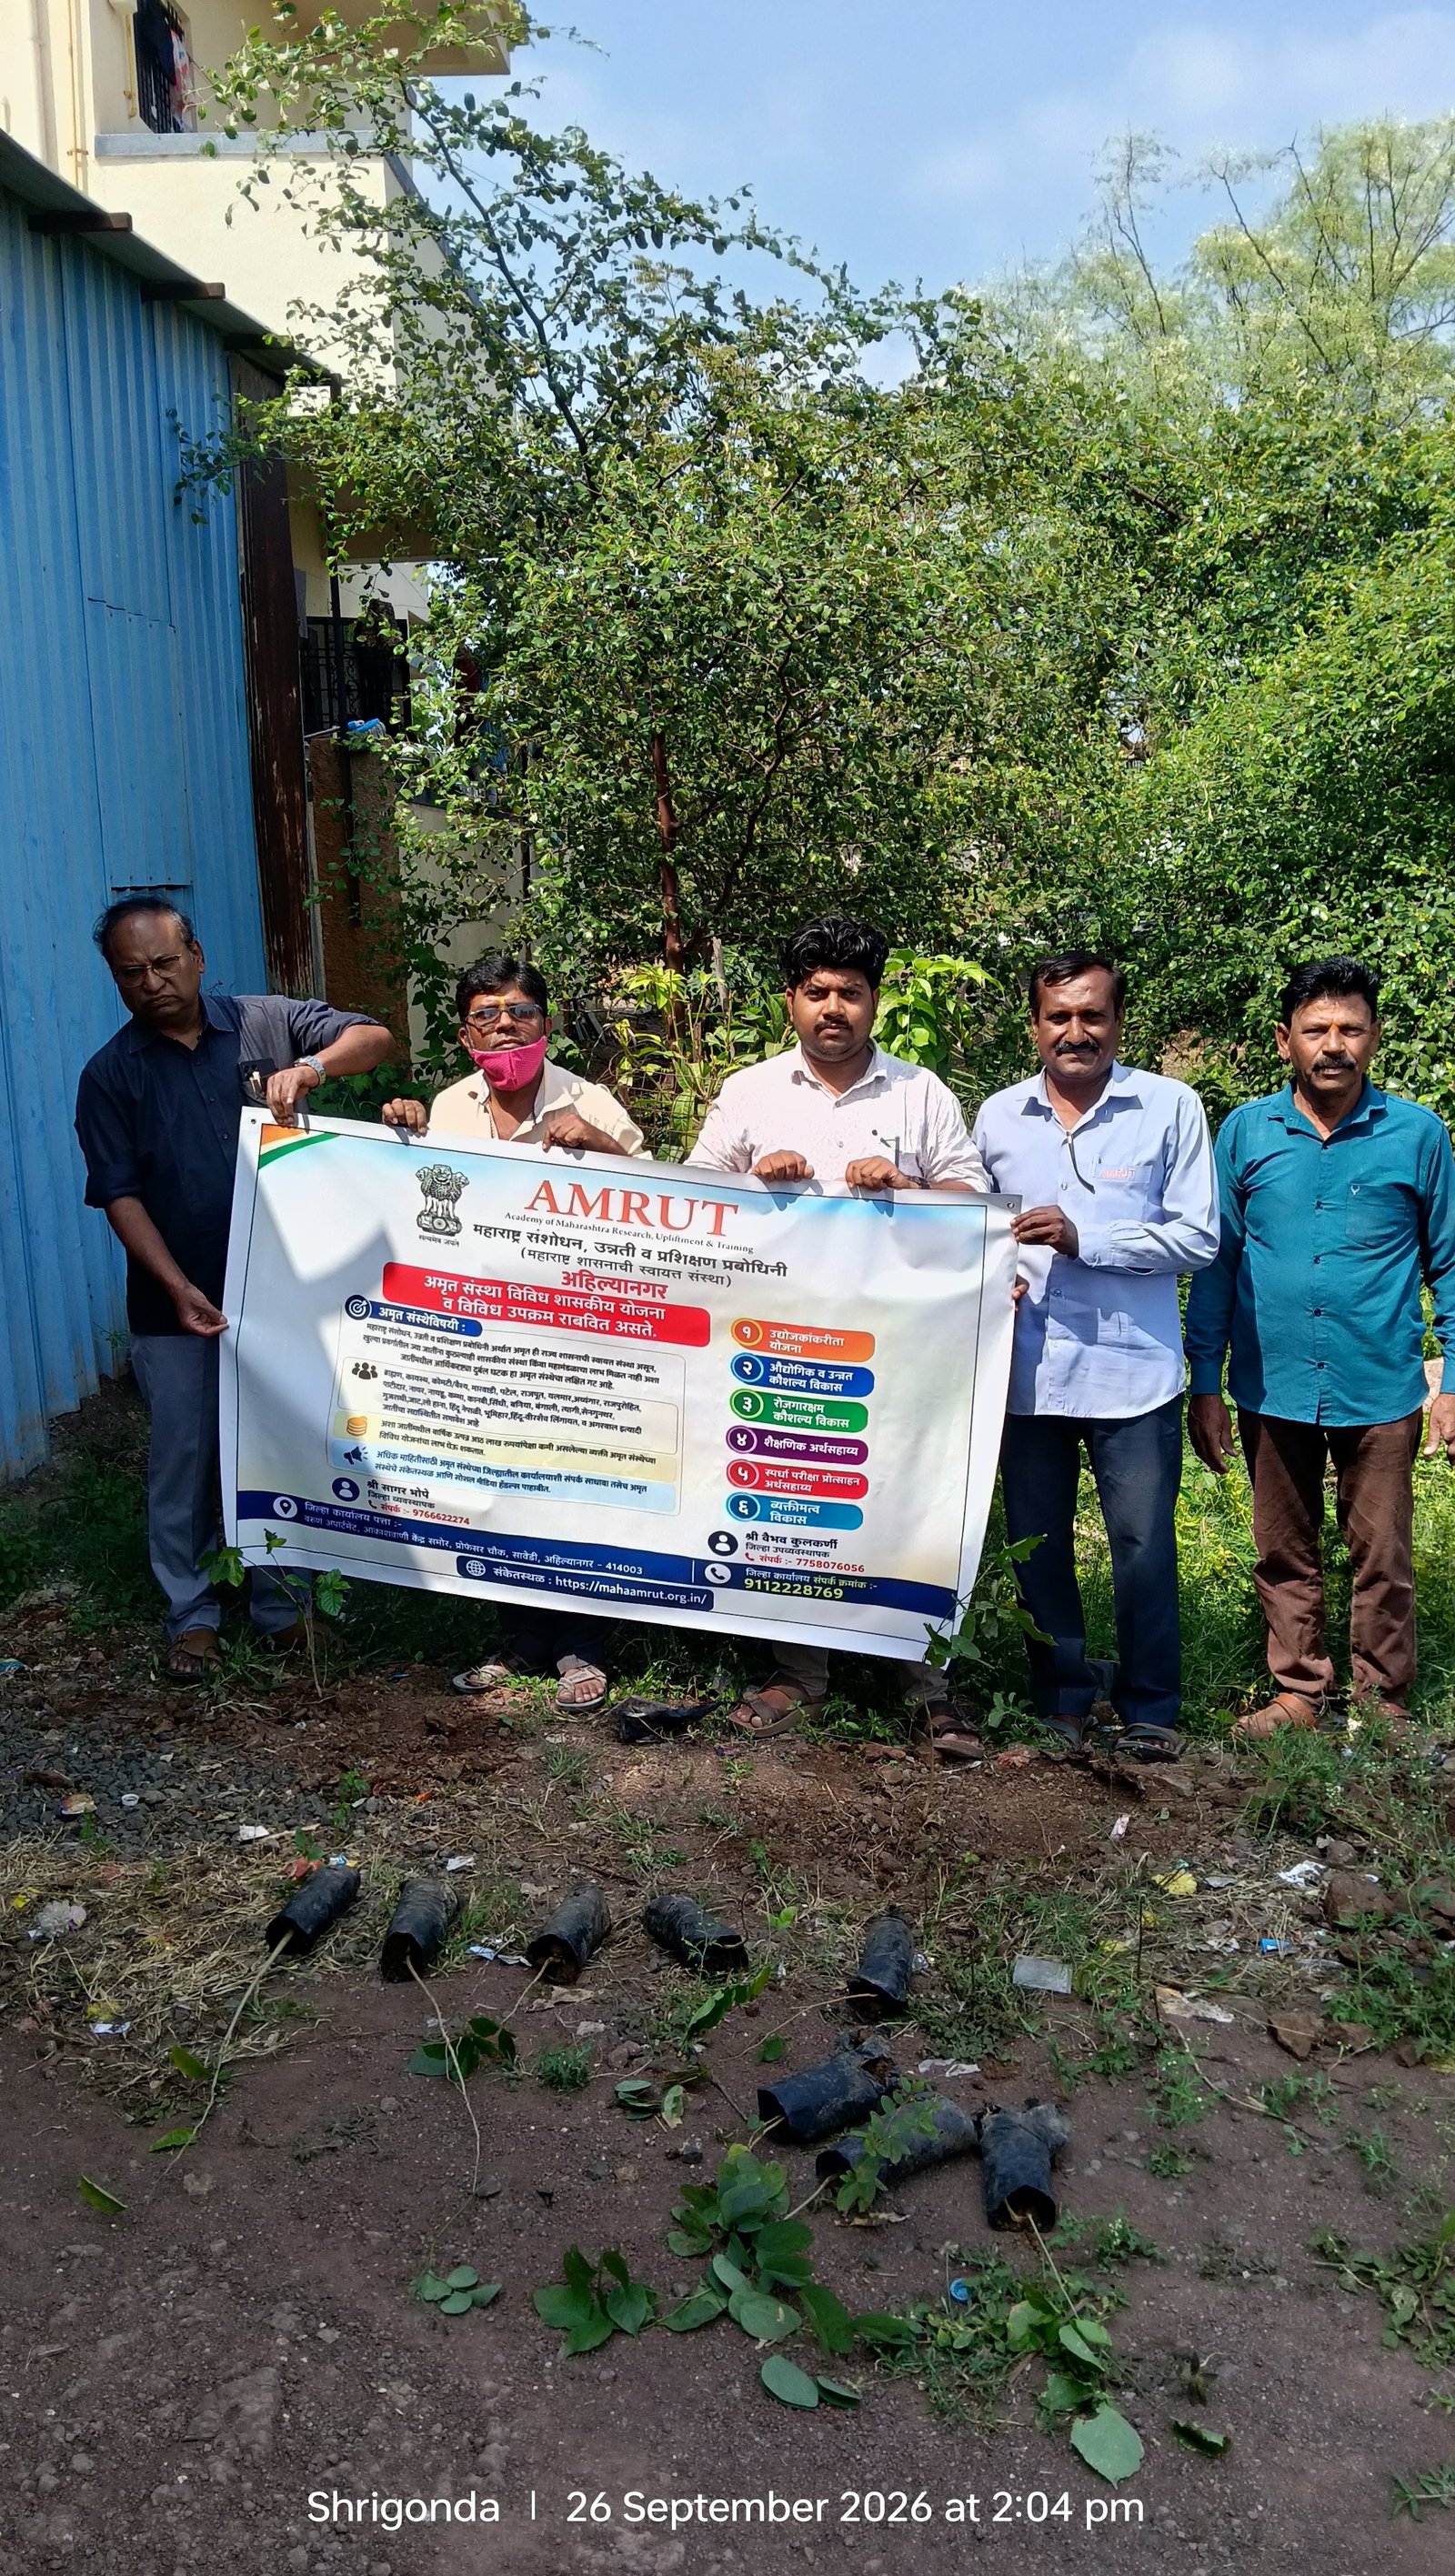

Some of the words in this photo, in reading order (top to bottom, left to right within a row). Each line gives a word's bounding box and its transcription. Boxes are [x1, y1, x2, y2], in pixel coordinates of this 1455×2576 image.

[523, 1179, 739, 1237] AMRUT
[505, 1211, 542, 1225] Academy
[556, 1218, 609, 1233] Maharashtra
[612, 1227, 653, 1239] Research,
[655, 1232, 703, 1246] Upliftment
[717, 1241, 753, 1254] Training
[473, 1223, 521, 1244] महाराष्ट्र
[526, 1228, 587, 1253] संशोधन,
[594, 1241, 637, 1258] उन्नती
[640, 1248, 652, 1259] व
[657, 1248, 717, 1268] प्रशिक्षण
[721, 1258, 788, 1277] प्रबोधिनी
[577, 1256, 633, 1273] शासनाची
[638, 1265, 682, 1279] स्वायत्त
[687, 1269, 731, 1288] संस्था)
[560, 1268, 668, 1299] अहिल्यानगर
[424, 1275, 458, 1295] अमृत
[461, 1279, 502, 1298] संस्था
[507, 1284, 549, 1308] विविध
[553, 1293, 616, 1313] शासकीय
[619, 1298, 666, 1319] योजना
[378, 1306, 405, 1324] अमृत
[406, 1309, 459, 1331] संस्थेविषयी
[442, 1297, 454, 1309] व
[457, 1296, 503, 1318] विविध
[507, 1302, 555, 1323] उपक्रम
[557, 1310, 610, 1330] राबवित
[615, 1317, 657, 1337] असते.
[742, 1326, 751, 1338] १
[769, 1328, 844, 1346] उद्योजकांकरीता
[436, 1336, 462, 1347] प्रशिक्षण
[462, 1339, 489, 1351] प्रबोधिनी
[491, 1344, 512, 1353] अर्थात
[513, 1347, 530, 1357] अमृत
[531, 1347, 539, 1356] ही
[557, 1352, 590, 1362] शासनाची
[615, 1359, 635, 1368] संस्था
[637, 1362, 657, 1373] असून,
[768, 1338, 802, 1354] योजना
[477, 1353, 507, 1365] शासकीय
[507, 1357, 527, 1366] संस्था
[588, 1368, 605, 1376] लाभ
[627, 1372, 642, 1382] नाही
[644, 1375, 659, 1384] अशा
[742, 1360, 752, 1375] २
[769, 1360, 816, 1379] औद्योगिक
[817, 1368, 826, 1378] व
[519, 1371, 537, 1381] अमृत
[537, 1371, 563, 1382] संस्थेचा
[587, 1378, 597, 1387] गट
[598, 1379, 614, 1390] आहे.
[768, 1372, 808, 1388] कौशल्य
[808, 1378, 843, 1393] विकास
[499, 1387, 519, 1397] पटेल,
[520, 1389, 546, 1400] राजपूत,
[742, 1396, 752, 1412] ३
[773, 1396, 825, 1413] रोजगारक्षम
[467, 1418, 479, 1428] आहे
[772, 1408, 813, 1425] कौशल्य
[815, 1413, 849, 1428] विकास
[736, 1432, 747, 1446] ४
[763, 1434, 807, 1451] शैक्षणिक
[808, 1442, 858, 1456] अर्थसहाय्य
[485, 1438, 502, 1447] लाख
[610, 1450, 627, 1461] अमृत
[376, 1449, 398, 1459] अधिक
[399, 1453, 437, 1465] माहितीसाठी
[438, 1459, 455, 1470] अमृत
[520, 1470, 562, 1481] कार्यालयाशी
[563, 1474, 583, 1483] संपर्क
[610, 1479, 628, 1489] तसेच
[630, 1484, 647, 1494] अमृत
[398, 1465, 434, 1477] संकेतस्थळ
[436, 1470, 453, 1479] आणि
[738, 1466, 748, 1481] ५
[764, 1468, 789, 1479] स्पर्धा
[790, 1469, 819, 1481] परीक्षा
[821, 1472, 860, 1486] प्रोत्साहन
[366, 1478, 378, 1489] श्री
[381, 1483, 406, 1495] सागर
[409, 1487, 429, 1498] भोपे
[764, 1478, 812, 1493] अर्थसहाय्य
[367, 1488, 390, 1501] जिल्हा
[392, 1496, 435, 1509] व्यवस्थापक
[738, 1499, 748, 1515] ६
[769, 1498, 820, 1514] व्यक्तीमत्व
[304, 1500, 329, 1515] जिल्हा
[332, 1509, 370, 1521] कार्यालय
[372, 1516, 391, 1526] पत्ता
[380, 1502, 401, 1513] संपर्क
[412, 1509, 470, 1525] 9766622274
[769, 1510, 808, 1525] विकास
[304, 1514, 323, 1525] वरुण
[326, 1519, 360, 1533] अपार्टमेंट,
[363, 1526, 409, 1540] आकाशवाणी
[411, 1532, 425, 1544] केंद्र
[427, 1537, 452, 1549] समोर,
[455, 1539, 485, 1553] प्रोफेसर
[487, 1545, 508, 1559] चौक,
[511, 1549, 540, 1563] सावेडी,
[544, 1554, 594, 1568] अहिल्यानगर
[605, 1561, 642, 1574] 414003
[745, 1530, 758, 1541] श्री
[761, 1531, 787, 1544] वैभव
[790, 1537, 838, 1549] कुलकर्णी
[745, 1541, 770, 1552] जिल्हा
[772, 1546, 829, 1558] उपव्यवस्थापक
[758, 1553, 782, 1564] संपर्क
[796, 1558, 865, 1572] 7758076056
[492, 1566, 545, 1583] संकेतस्थळ
[555, 1575, 707, 1604] https://mahaamrut.org.in/
[745, 1567, 771, 1579] जिल्हा
[773, 1571, 810, 1582] कार्यालय
[812, 1574, 837, 1585] संपर्क
[838, 1579, 867, 1589] क्रमांक
[744, 1578, 843, 1599] 9112228769
